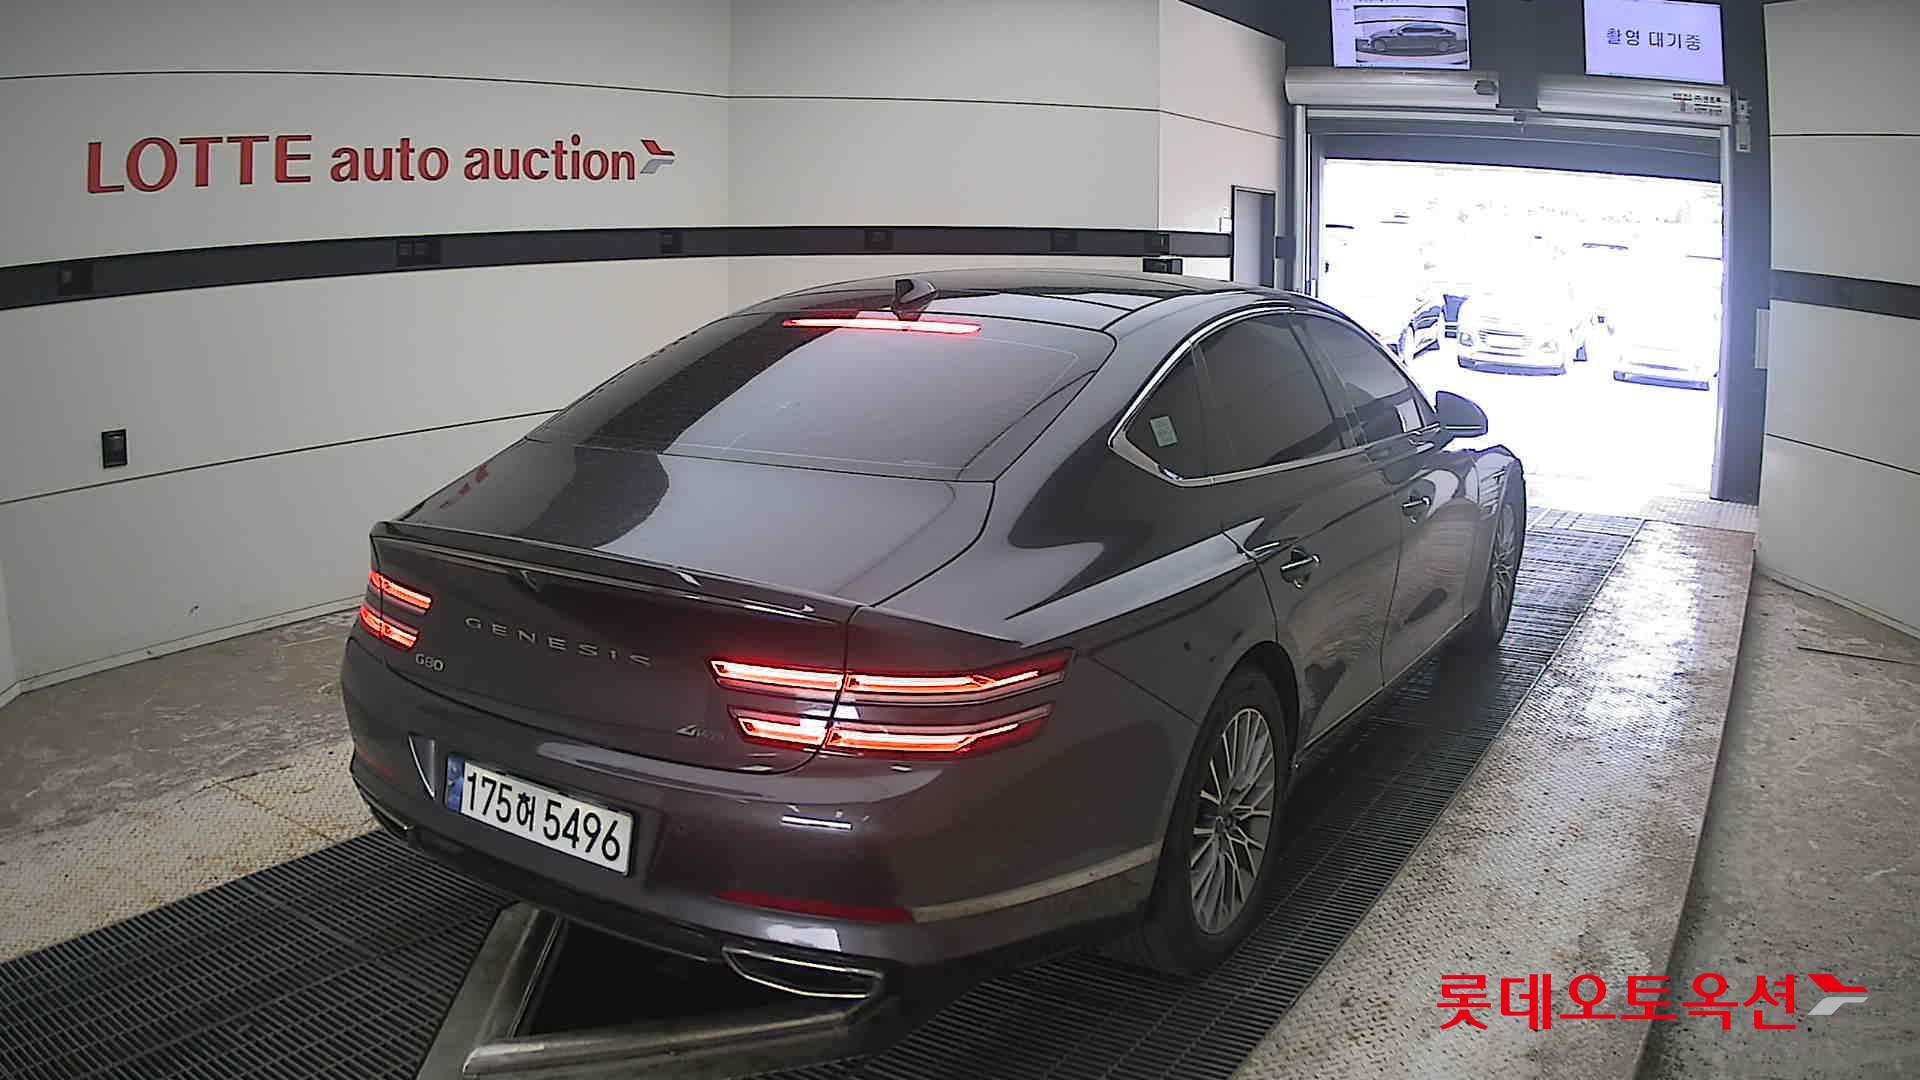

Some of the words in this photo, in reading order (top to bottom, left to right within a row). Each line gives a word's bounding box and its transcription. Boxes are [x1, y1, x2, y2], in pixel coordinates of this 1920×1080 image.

[87, 134, 312, 194] LOTTE
[329, 137, 449, 182] auto
[463, 133, 636, 181] auction
[415, 652, 445, 672] G80
[464, 616, 651, 666] GENESIS
